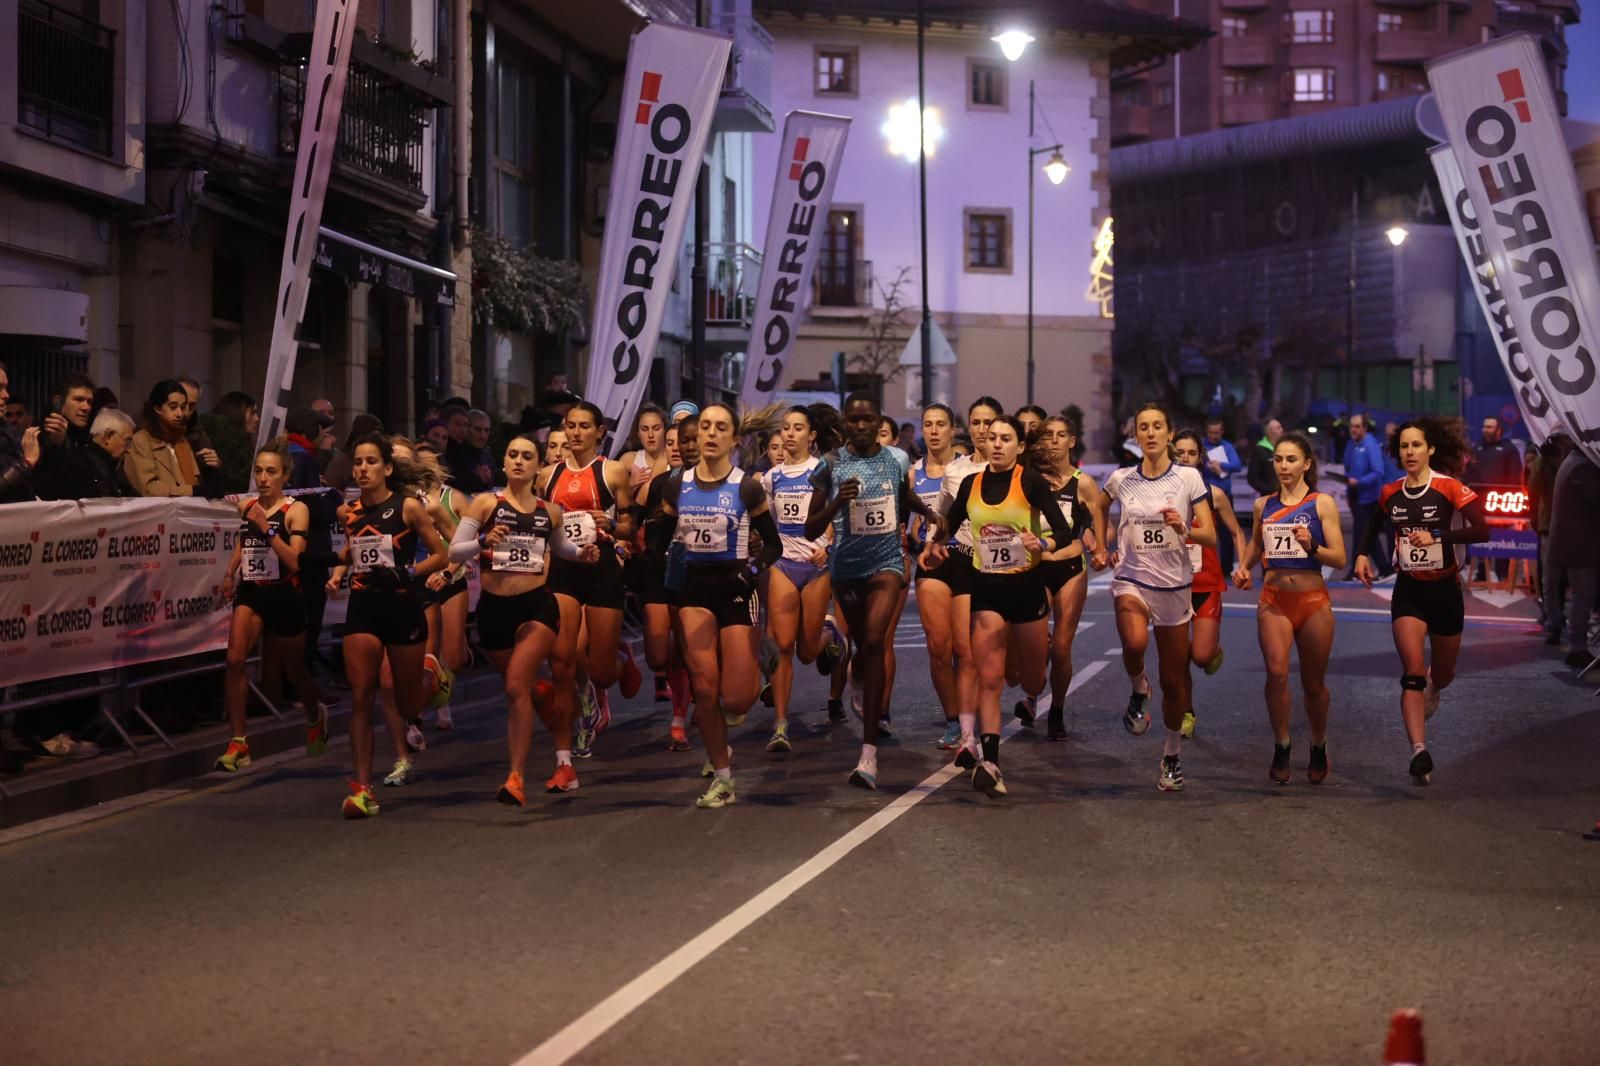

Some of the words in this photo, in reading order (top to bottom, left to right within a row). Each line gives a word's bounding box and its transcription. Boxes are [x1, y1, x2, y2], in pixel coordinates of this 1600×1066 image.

[612, 103, 691, 385] CORREO
[756, 160, 826, 392] CORREO
[784, 504, 799, 516] 59
[866, 511, 885, 526] 63
[564, 524, 582, 538] 53
[694, 529, 711, 543] 76
[1144, 530, 1163, 544] 86
[108, 537, 120, 558] EL
[122, 534, 160, 557] CORREO
[170, 533, 179, 553] EL
[181, 531, 216, 552] CORREO
[224, 531, 233, 550] EL
[988, 536, 1013, 544] CORREO
[1274, 536, 1291, 550] 71
[42, 542, 54, 563] EL
[56, 538, 98, 561] CORREO
[361, 549, 379, 563] 69
[509, 548, 529, 562] 88
[990, 548, 1010, 563] 78
[1410, 549, 1428, 562] 62
[249, 560, 265, 572] 54
[102, 606, 115, 627] EL
[116, 602, 156, 625] CORREO
[165, 600, 177, 620] EL
[37, 615, 49, 636] EL
[51, 608, 92, 633] CORREO
